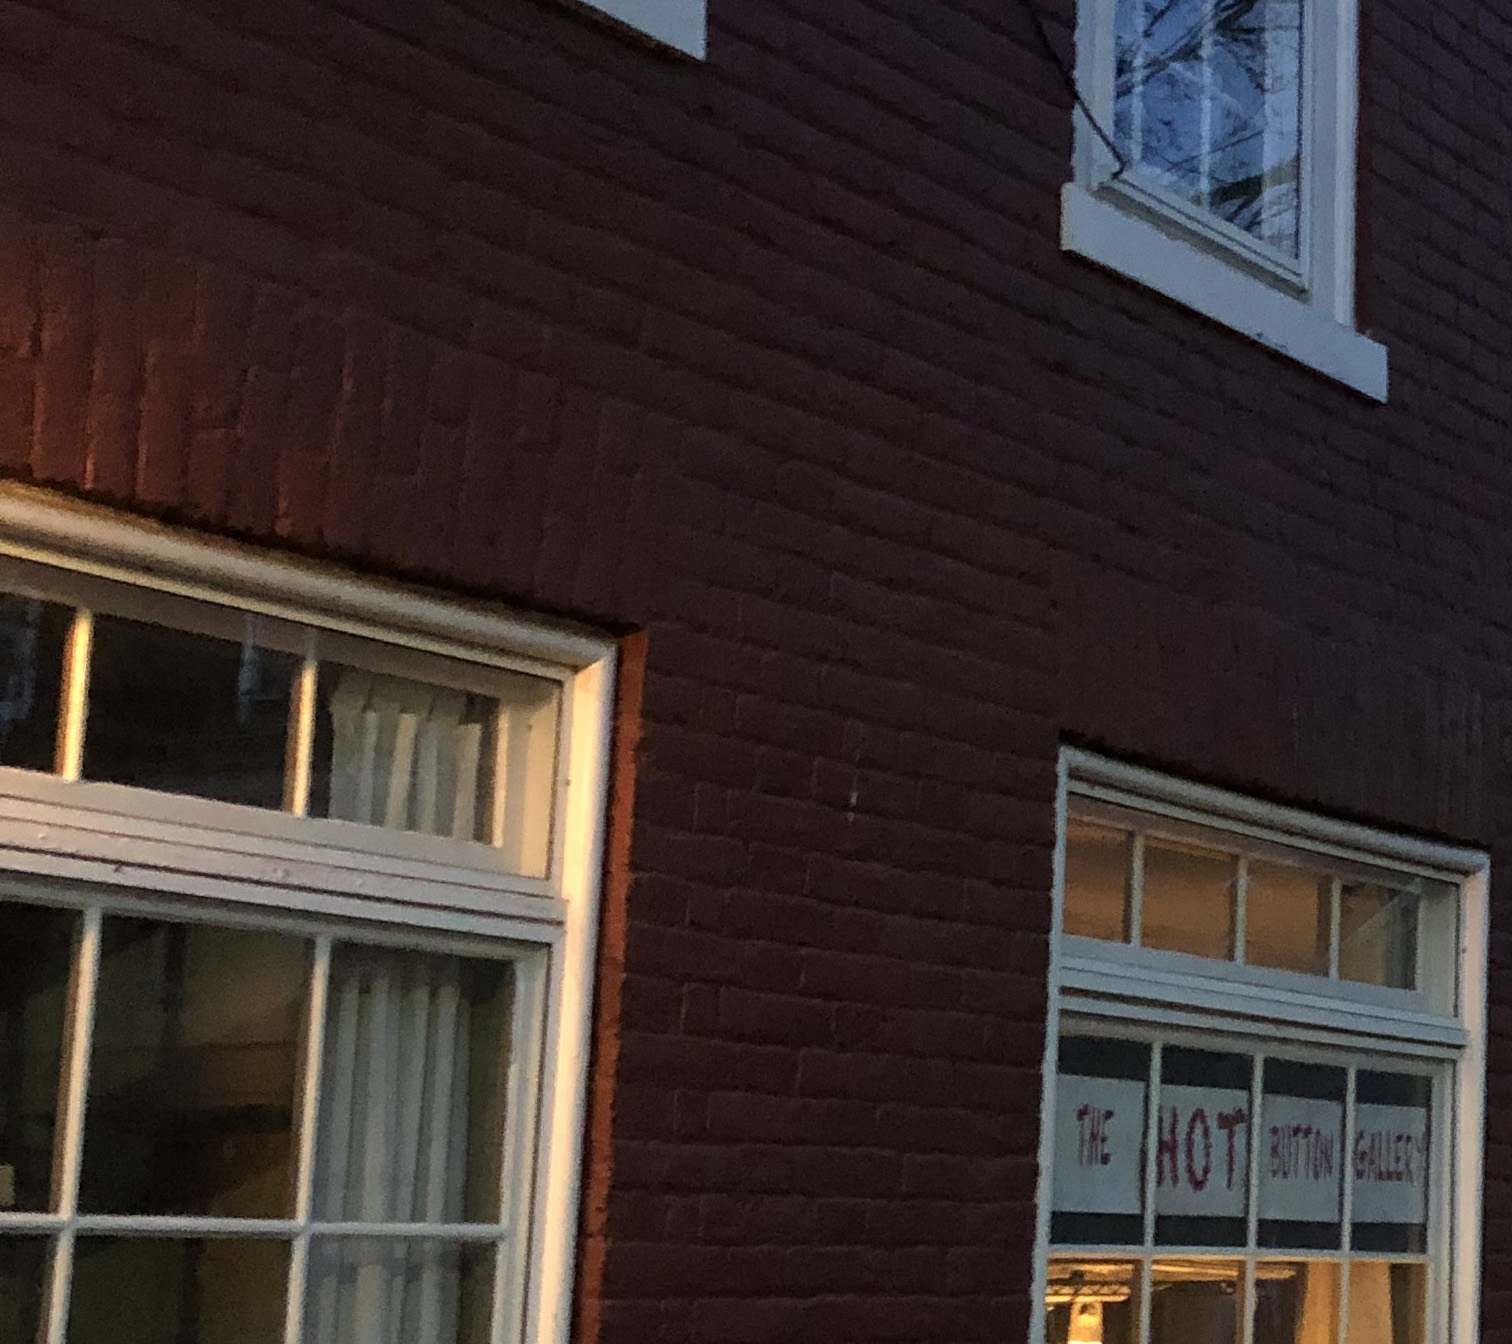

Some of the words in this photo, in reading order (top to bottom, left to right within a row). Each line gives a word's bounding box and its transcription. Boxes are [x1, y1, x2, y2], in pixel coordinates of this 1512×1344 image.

[1076, 1103, 1115, 1167] THE
[1156, 1104, 1248, 1192] HOT
[1269, 1123, 1334, 1181] BUTTON
